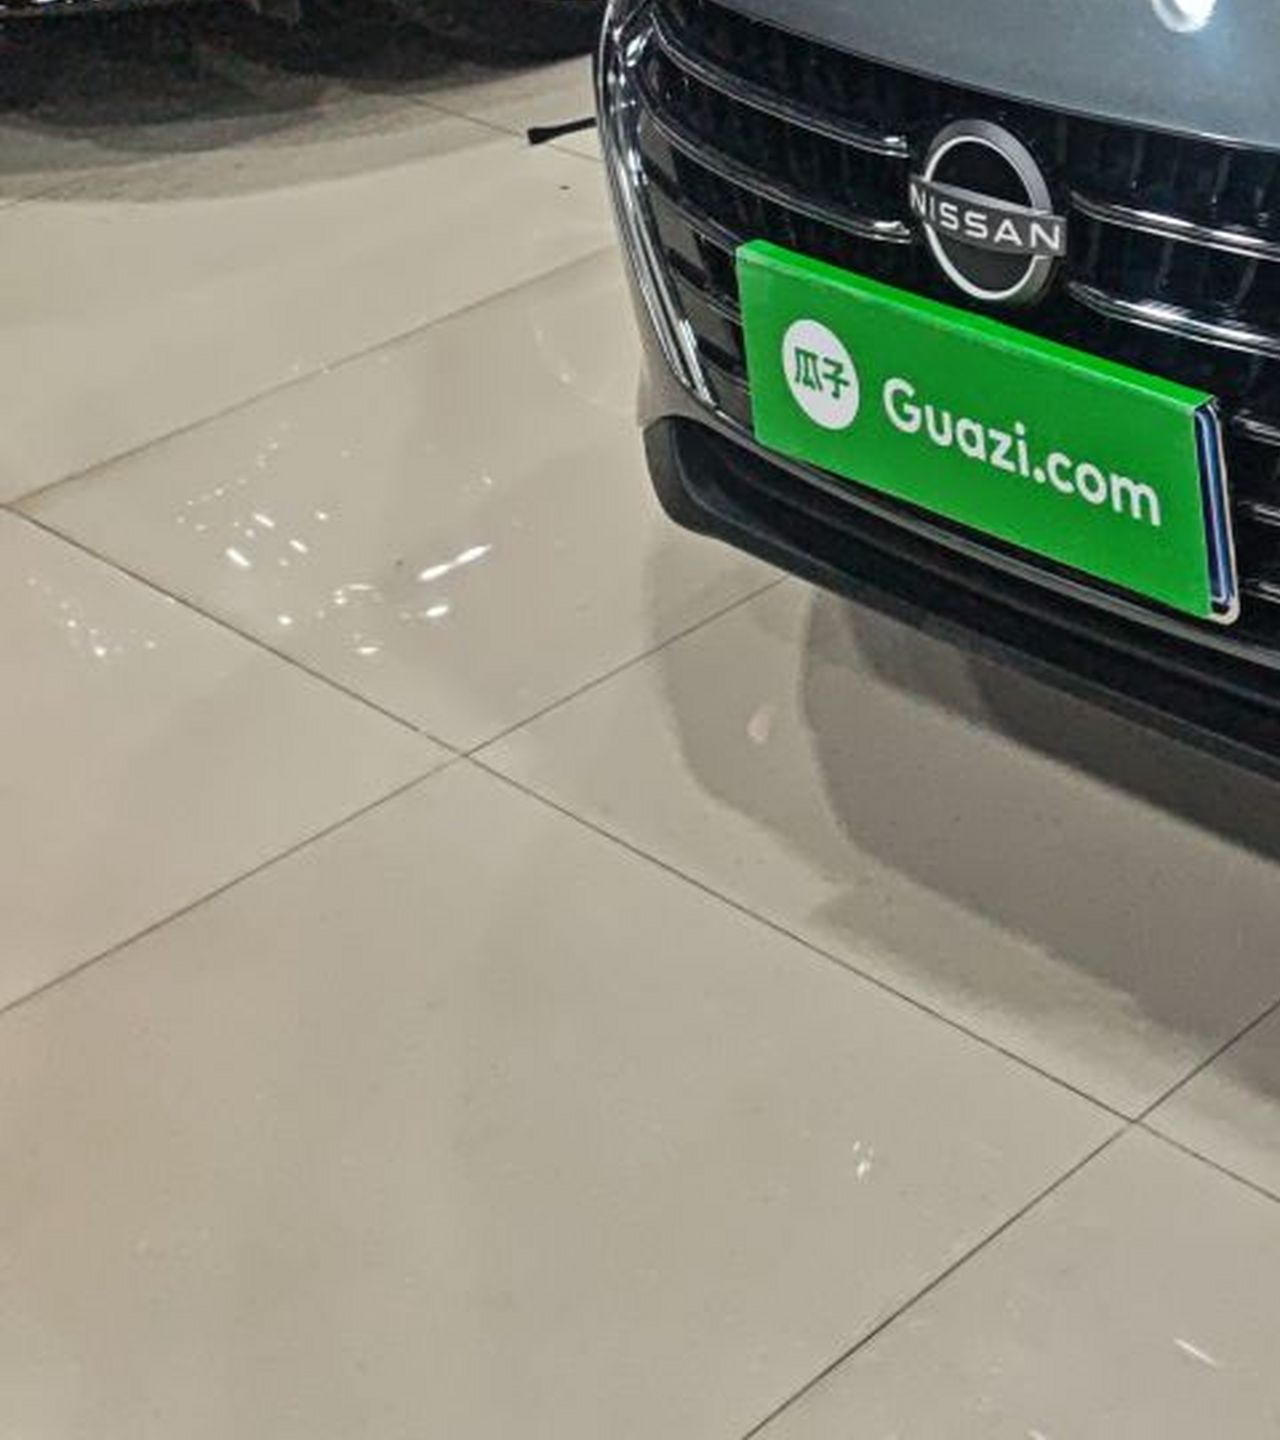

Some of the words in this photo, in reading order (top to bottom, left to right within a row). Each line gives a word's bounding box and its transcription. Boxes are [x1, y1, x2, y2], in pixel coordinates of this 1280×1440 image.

[910, 182, 1061, 251] NISSAN
[793, 345, 851, 400] 瓜子
[881, 377, 1163, 527] Guazi.com
